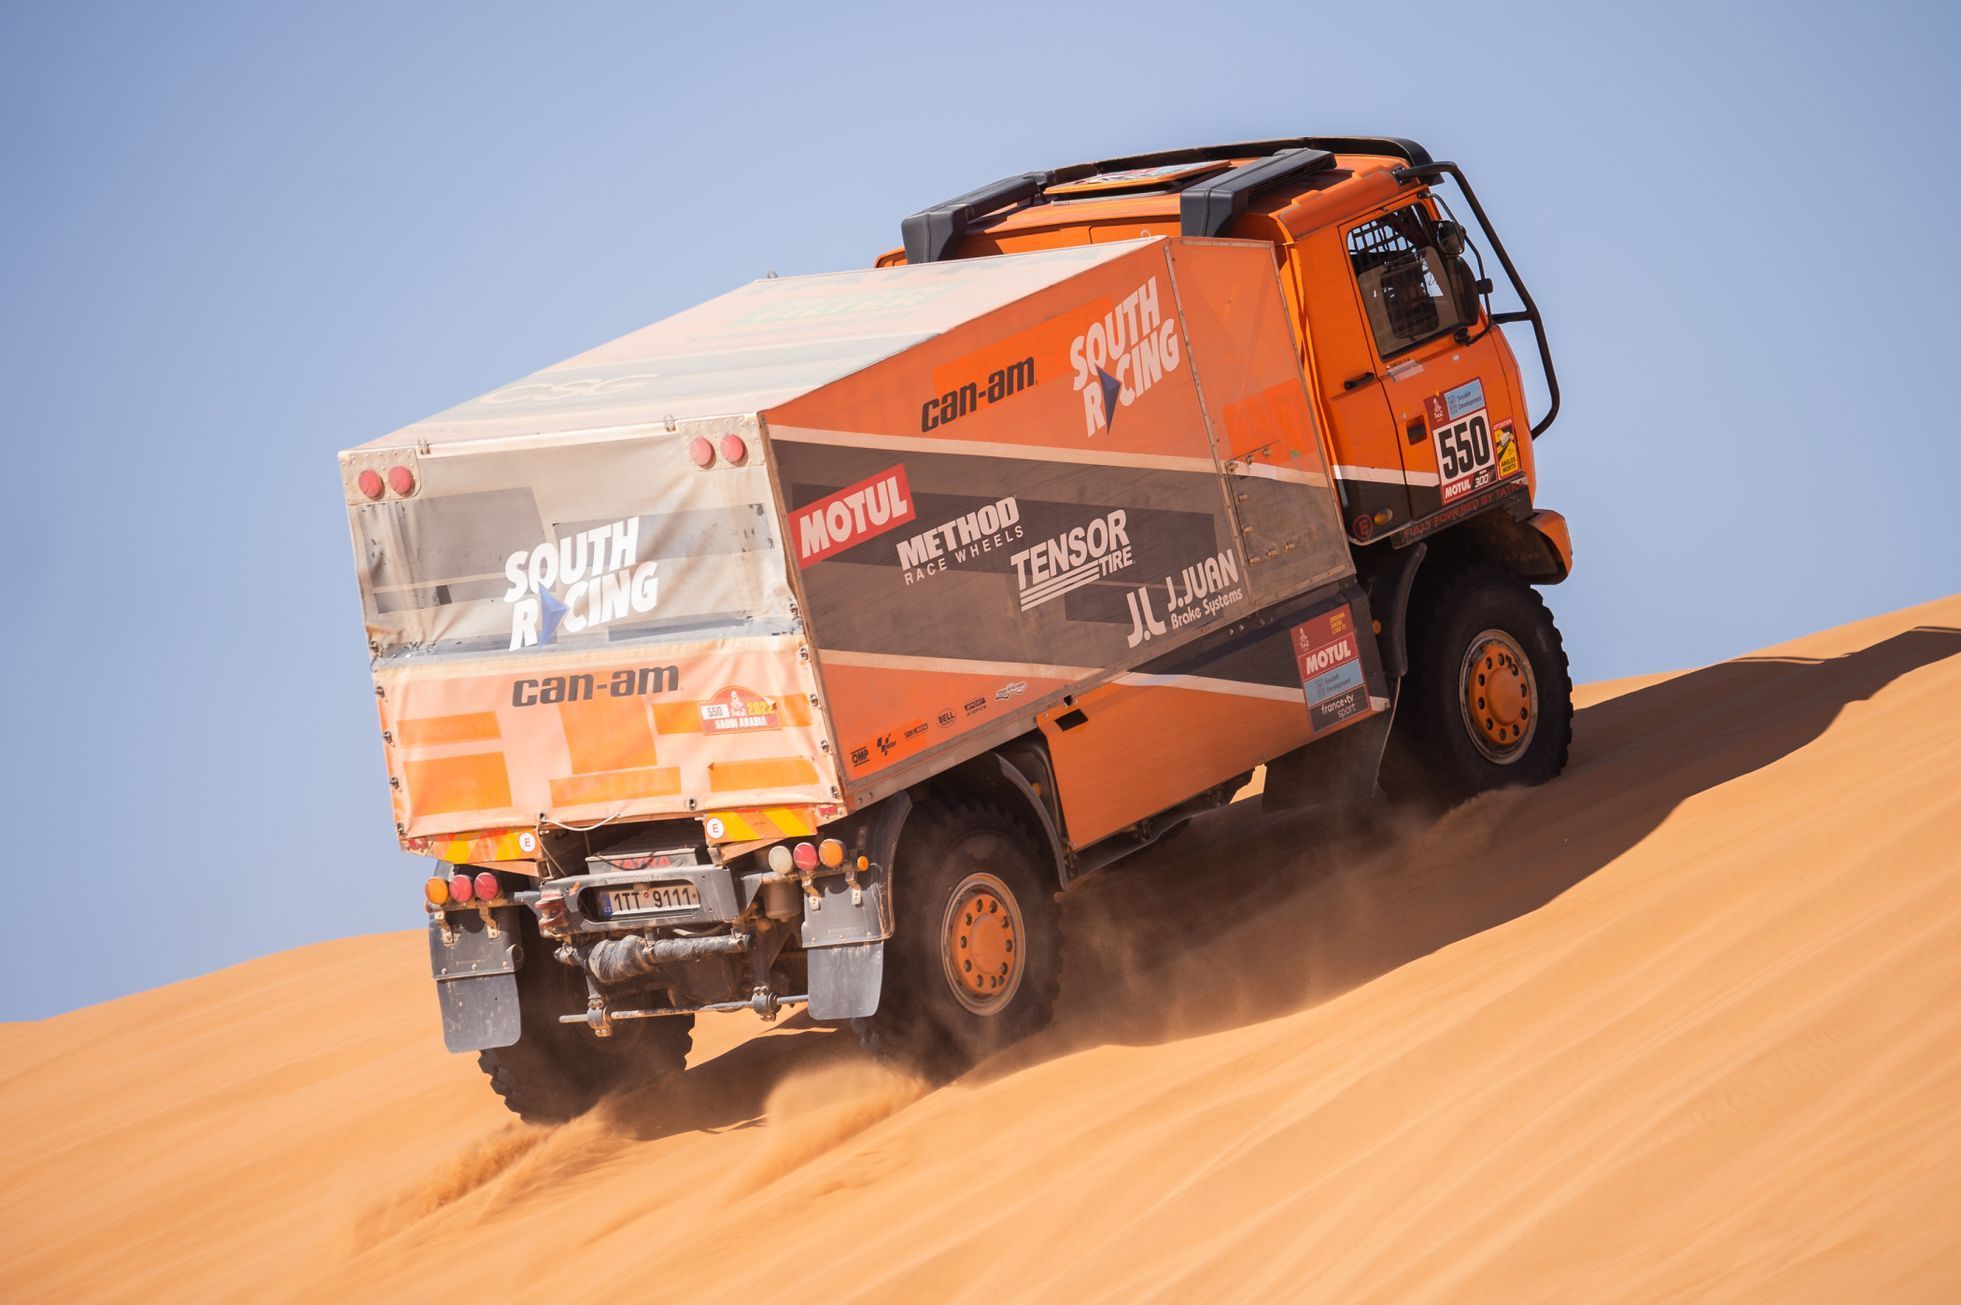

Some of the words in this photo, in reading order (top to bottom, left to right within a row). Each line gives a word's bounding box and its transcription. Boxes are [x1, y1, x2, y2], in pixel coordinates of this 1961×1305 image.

[1069, 275, 1161, 391] SOUTH
[921, 356, 1035, 433] can-am
[1438, 415, 1491, 479] 550
[1445, 479, 1472, 499] MOTUL
[799, 476, 908, 560] MOTUL
[895, 496, 1020, 572] METHOD
[1404, 519, 1432, 540] FULLY
[1434, 500, 1479, 525] POWERED
[1481, 493, 1494, 506] BY
[503, 516, 640, 604] SOUTH
[904, 558, 948, 586] RACE
[955, 525, 1024, 564] WHEELS
[1010, 509, 1130, 591] TENSOR
[1099, 545, 1133, 576] TIRE
[1170, 607, 1202, 630] Brake
[1202, 588, 1243, 616] Systems
[1306, 640, 1351, 675] MOTUL
[512, 665, 680, 708] can-am
[707, 706, 723, 717] 550
[714, 718, 738, 730] SAUDI
[739, 715, 768, 727] ARABIA
[938, 711, 955, 724] BELL
[1337, 703, 1356, 719] sport
[852, 749, 868, 764] OMP
[523, 837, 531, 847] E
[711, 823, 719, 833] E
[614, 891, 641, 911] 1TT
[652, 888, 691, 908] 9111
